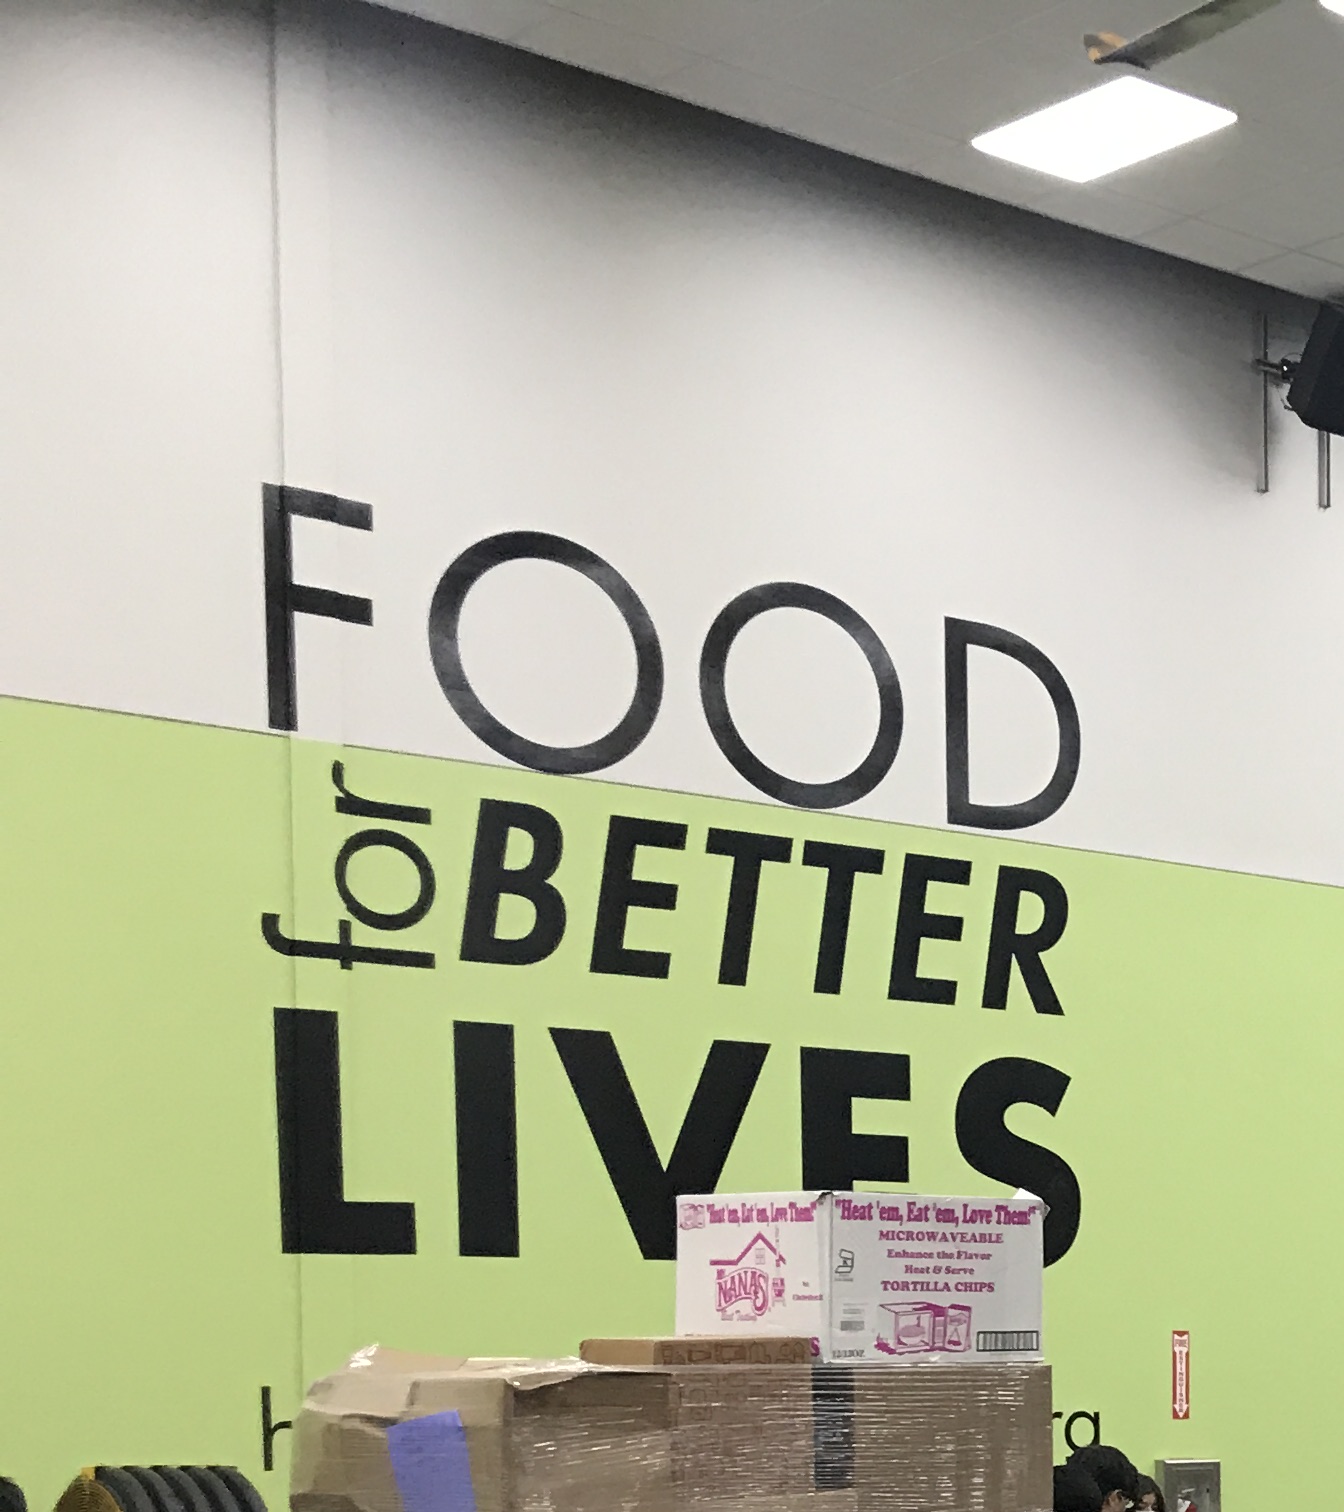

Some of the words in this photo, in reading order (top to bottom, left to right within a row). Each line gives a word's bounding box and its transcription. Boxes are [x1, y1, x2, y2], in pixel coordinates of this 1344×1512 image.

[262, 483, 1081, 832] FOOD
[262, 760, 436, 970] for
[459, 798, 1070, 1017] BETTER
[273, 1006, 1081, 1268] LIVES
[907, 1201, 930, 1223] Eat
[962, 1203, 993, 1225] Love
[879, 1230, 1004, 1244] MICROWAVEABLE
[887, 1249, 934, 1260] Enhance
[937, 1249, 955, 1260] the
[956, 1250, 992, 1261] Flavor
[904, 1264, 930, 1275] Heat
[944, 1265, 975, 1275] Serve
[881, 1280, 950, 1293] TORTILLA
[954, 1281, 995, 1293] CHIPS
